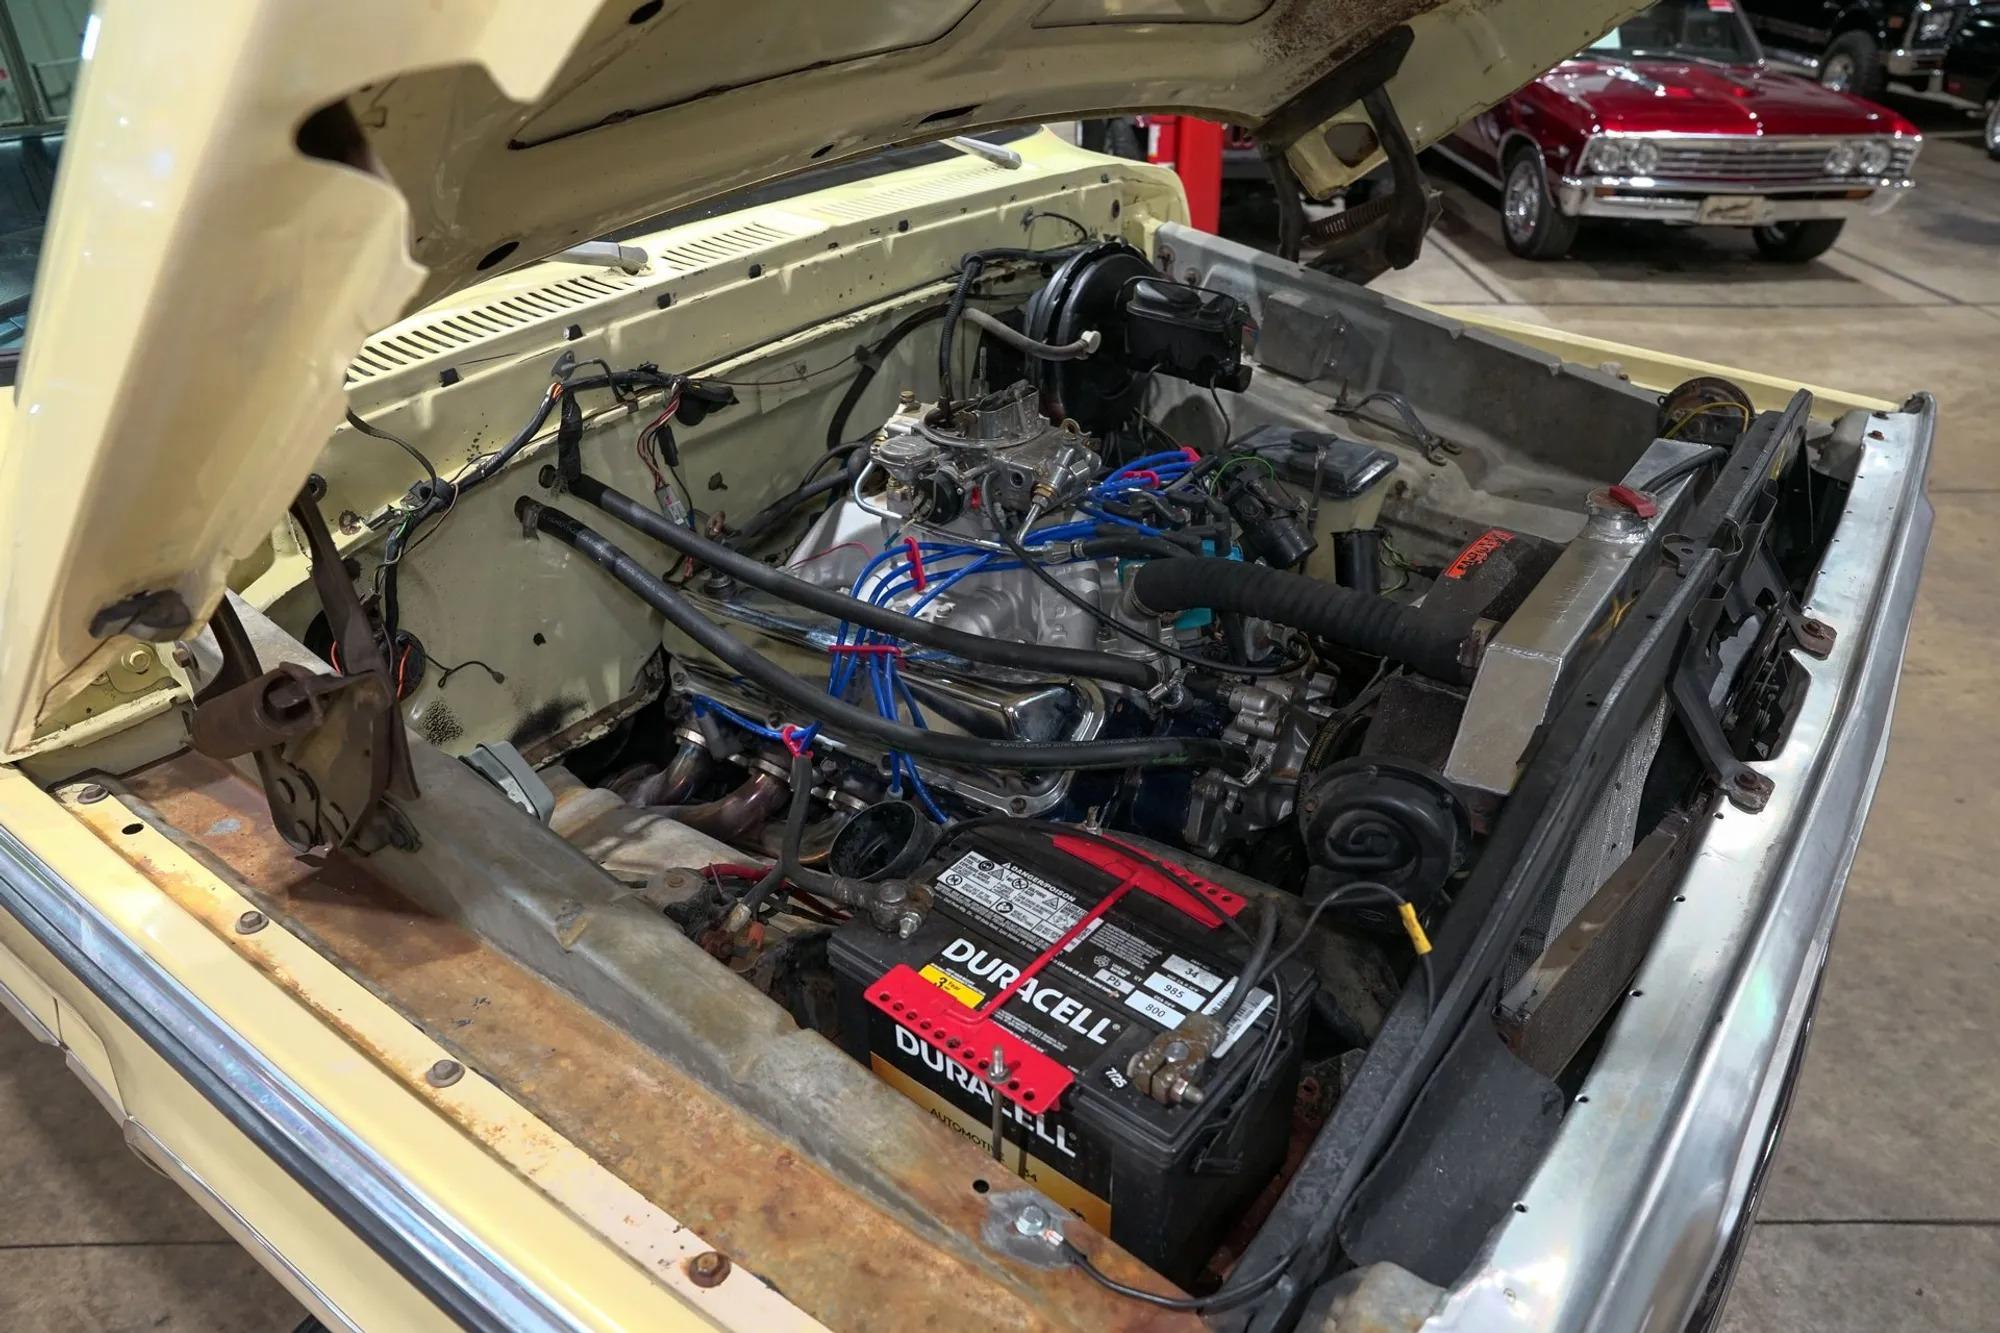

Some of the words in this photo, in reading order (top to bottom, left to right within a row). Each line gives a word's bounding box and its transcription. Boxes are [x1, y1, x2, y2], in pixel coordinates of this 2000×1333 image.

[1010, 864, 1077, 902] DANGER/POISON
[1184, 967, 1200, 978] 34
[933, 976, 948, 989] 3
[1106, 975, 1121, 987] Pb
[941, 937, 1112, 1045] DURACELL
[1163, 984, 1186, 999] 985
[1145, 1003, 1166, 1018] 800
[1105, 1067, 1127, 1088] 7/25
